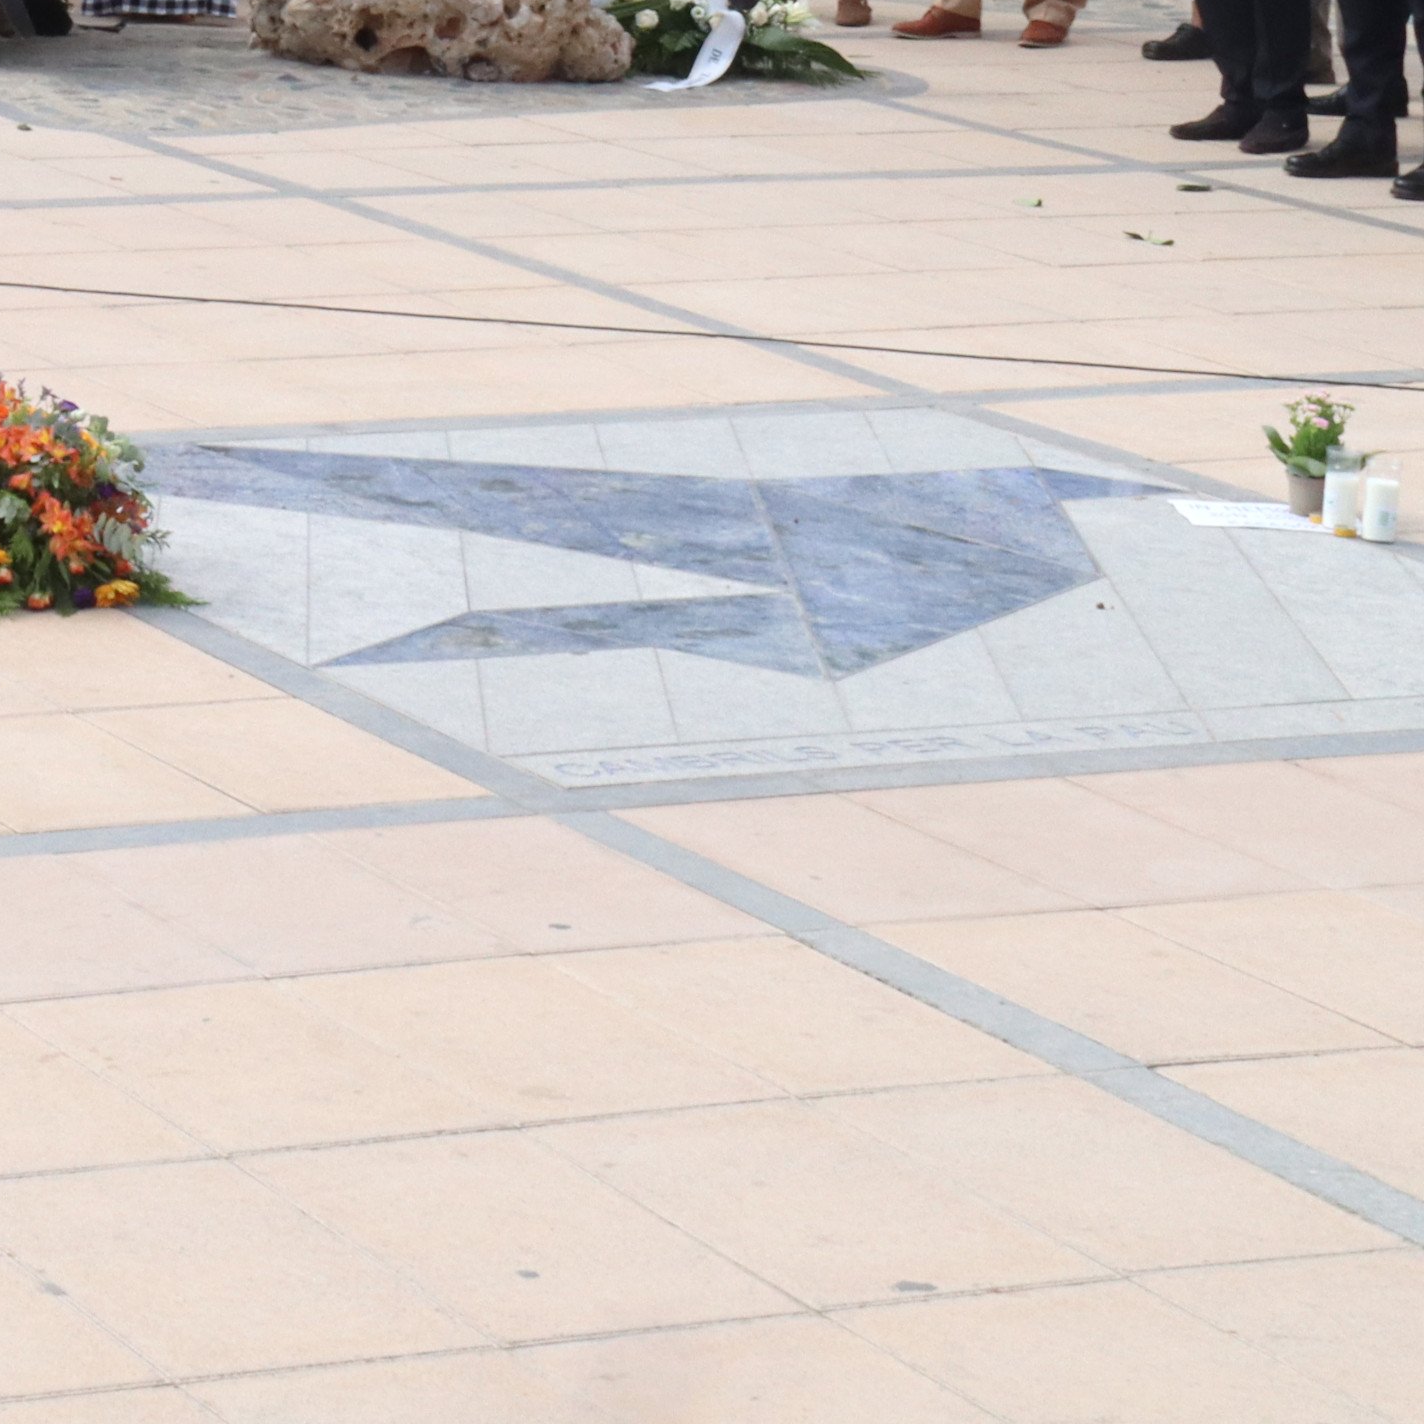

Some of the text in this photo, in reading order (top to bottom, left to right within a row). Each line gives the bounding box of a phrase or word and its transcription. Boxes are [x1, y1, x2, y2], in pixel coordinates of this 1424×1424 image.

[554, 720, 1196, 777] CAMBRILS PER LA PAU
